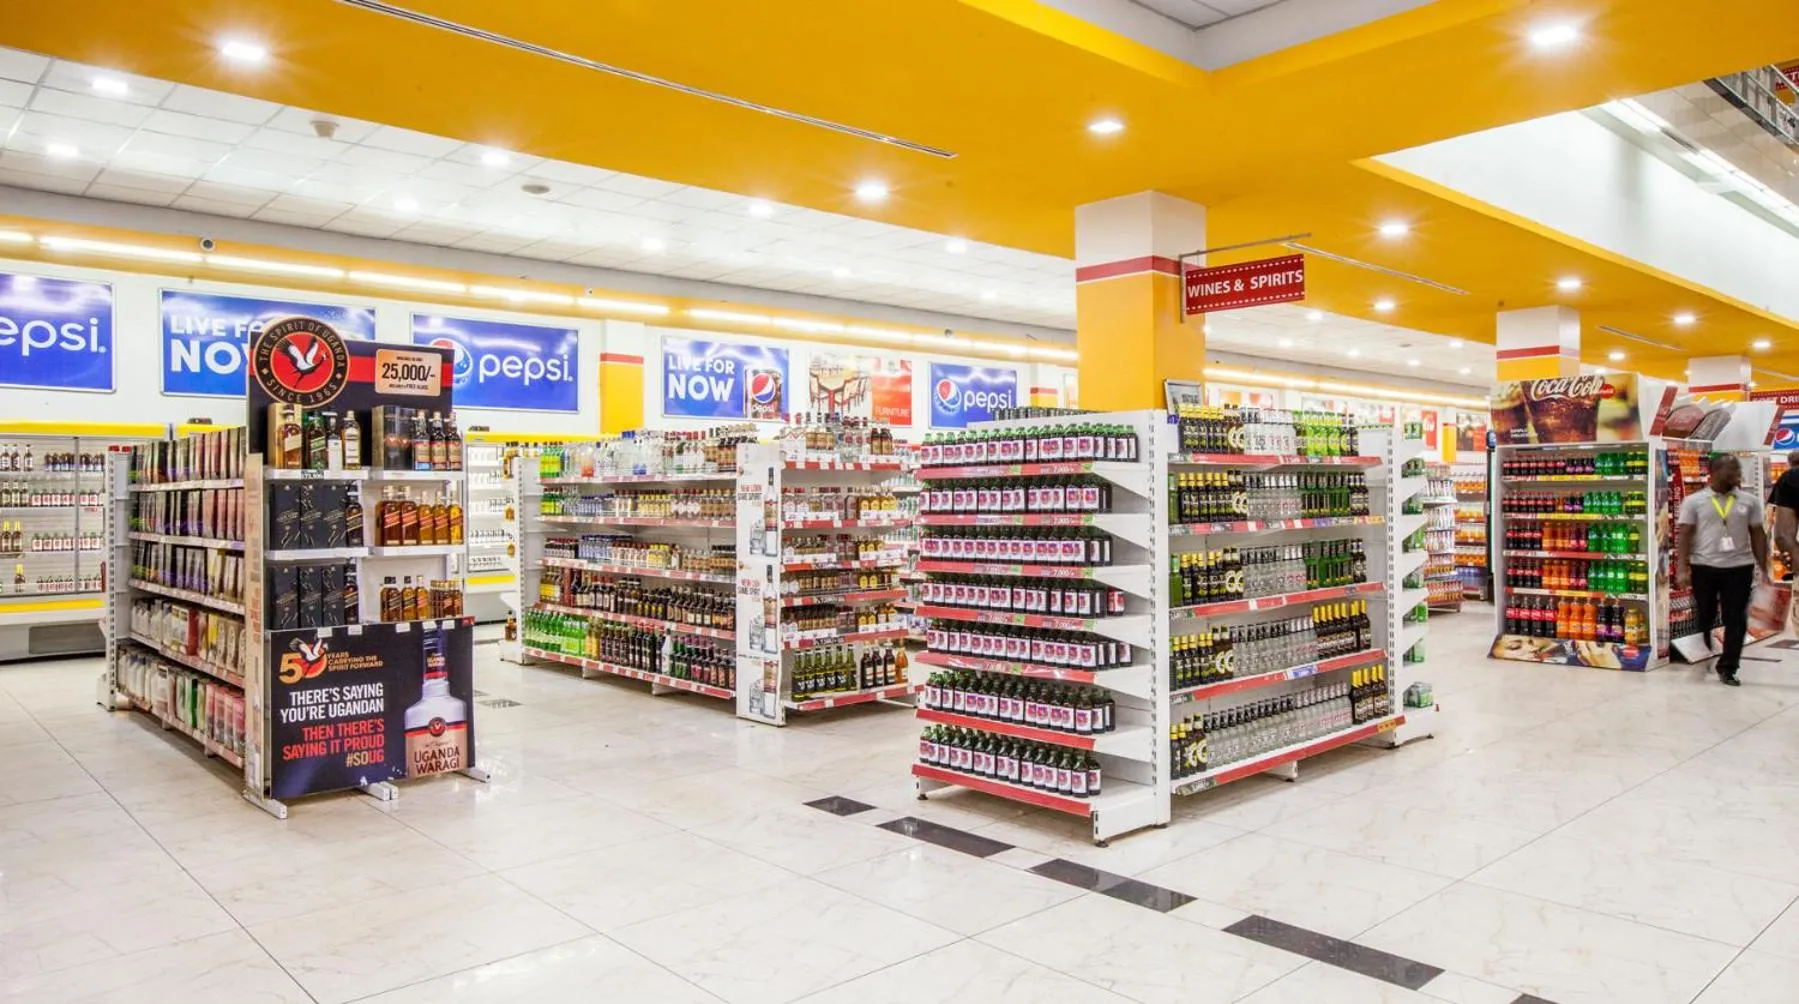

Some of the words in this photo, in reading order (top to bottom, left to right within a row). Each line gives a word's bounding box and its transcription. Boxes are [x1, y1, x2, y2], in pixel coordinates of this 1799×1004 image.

[1187, 280, 1231, 298] WINES
[1233, 278, 1245, 292] &
[1249, 269, 1304, 290] SPIRITS
[170, 314, 227, 337] LIVE
[259, 343, 273, 362] THE
[269, 320, 304, 341] SPIRIT
[306, 322, 322, 333] OF
[321, 328, 346, 367] UGANDA
[170, 338, 249, 375] NO
[667, 355, 702, 372] LIVE
[704, 359, 736, 375] FOR
[381, 362, 437, 383] 25,000/-
[266, 379, 303, 403] SINCE
[309, 381, 338, 403] 1965
[667, 373, 736, 402] NOW
[963, 389, 1013, 413] pepsi
[327, 651, 350, 660] YEARS
[289, 687, 341, 706] THERE'S
[342, 682, 384, 698] SAYING
[280, 705, 326, 724] YOU'RE
[328, 698, 385, 718] UGANDAN
[302, 725, 334, 742] THEN
[337, 718, 385, 738] THERE'S
[282, 740, 327, 761] SAYING
[329, 737, 342, 755] IT
[343, 733, 385, 753] PROUD
[413, 745, 460, 763] UGANDA
[345, 753, 385, 768] #SOUG
[415, 757, 460, 775] WARAGI
